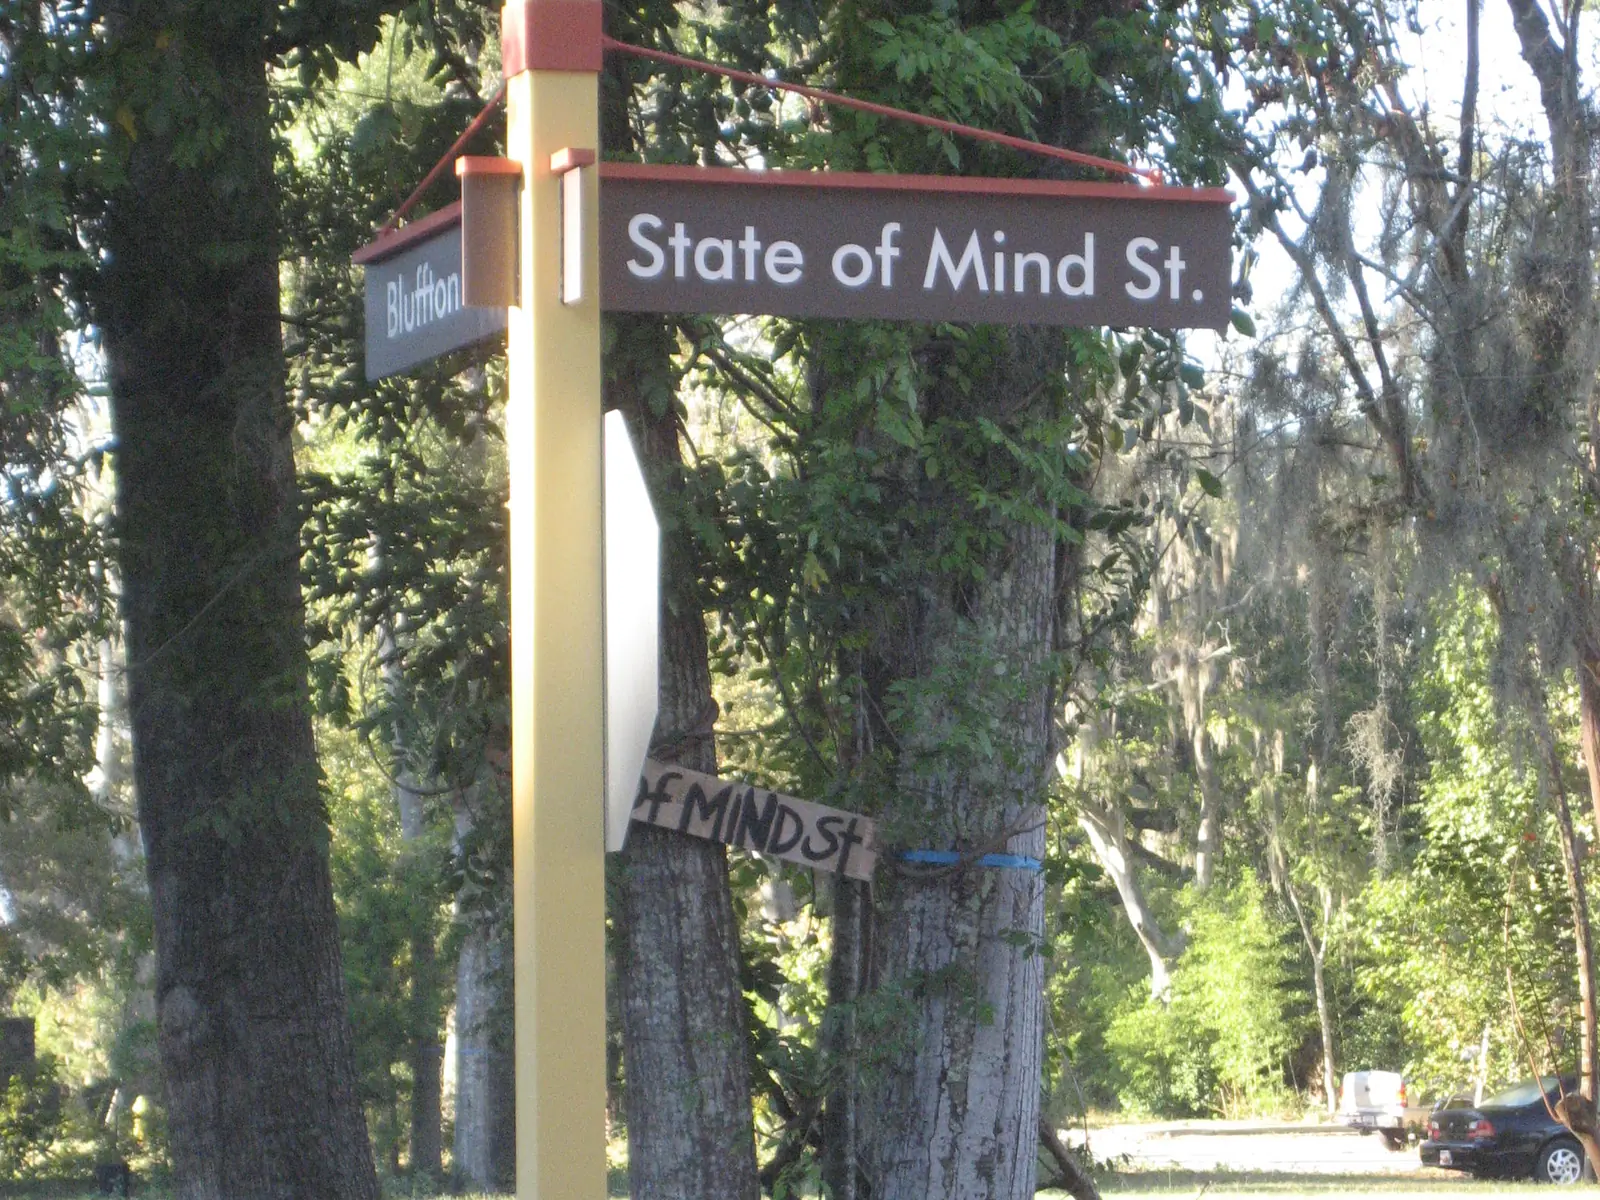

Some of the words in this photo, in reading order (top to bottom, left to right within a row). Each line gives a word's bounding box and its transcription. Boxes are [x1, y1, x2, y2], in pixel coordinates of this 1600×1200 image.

[387, 262, 460, 338] Bluffton
[626, 213, 804, 285] State
[831, 221, 901, 287] of
[923, 227, 1096, 297] Mind
[1124, 237, 1204, 301] St.
[679, 781, 804, 855] MIND
[801, 816, 863, 878] St
